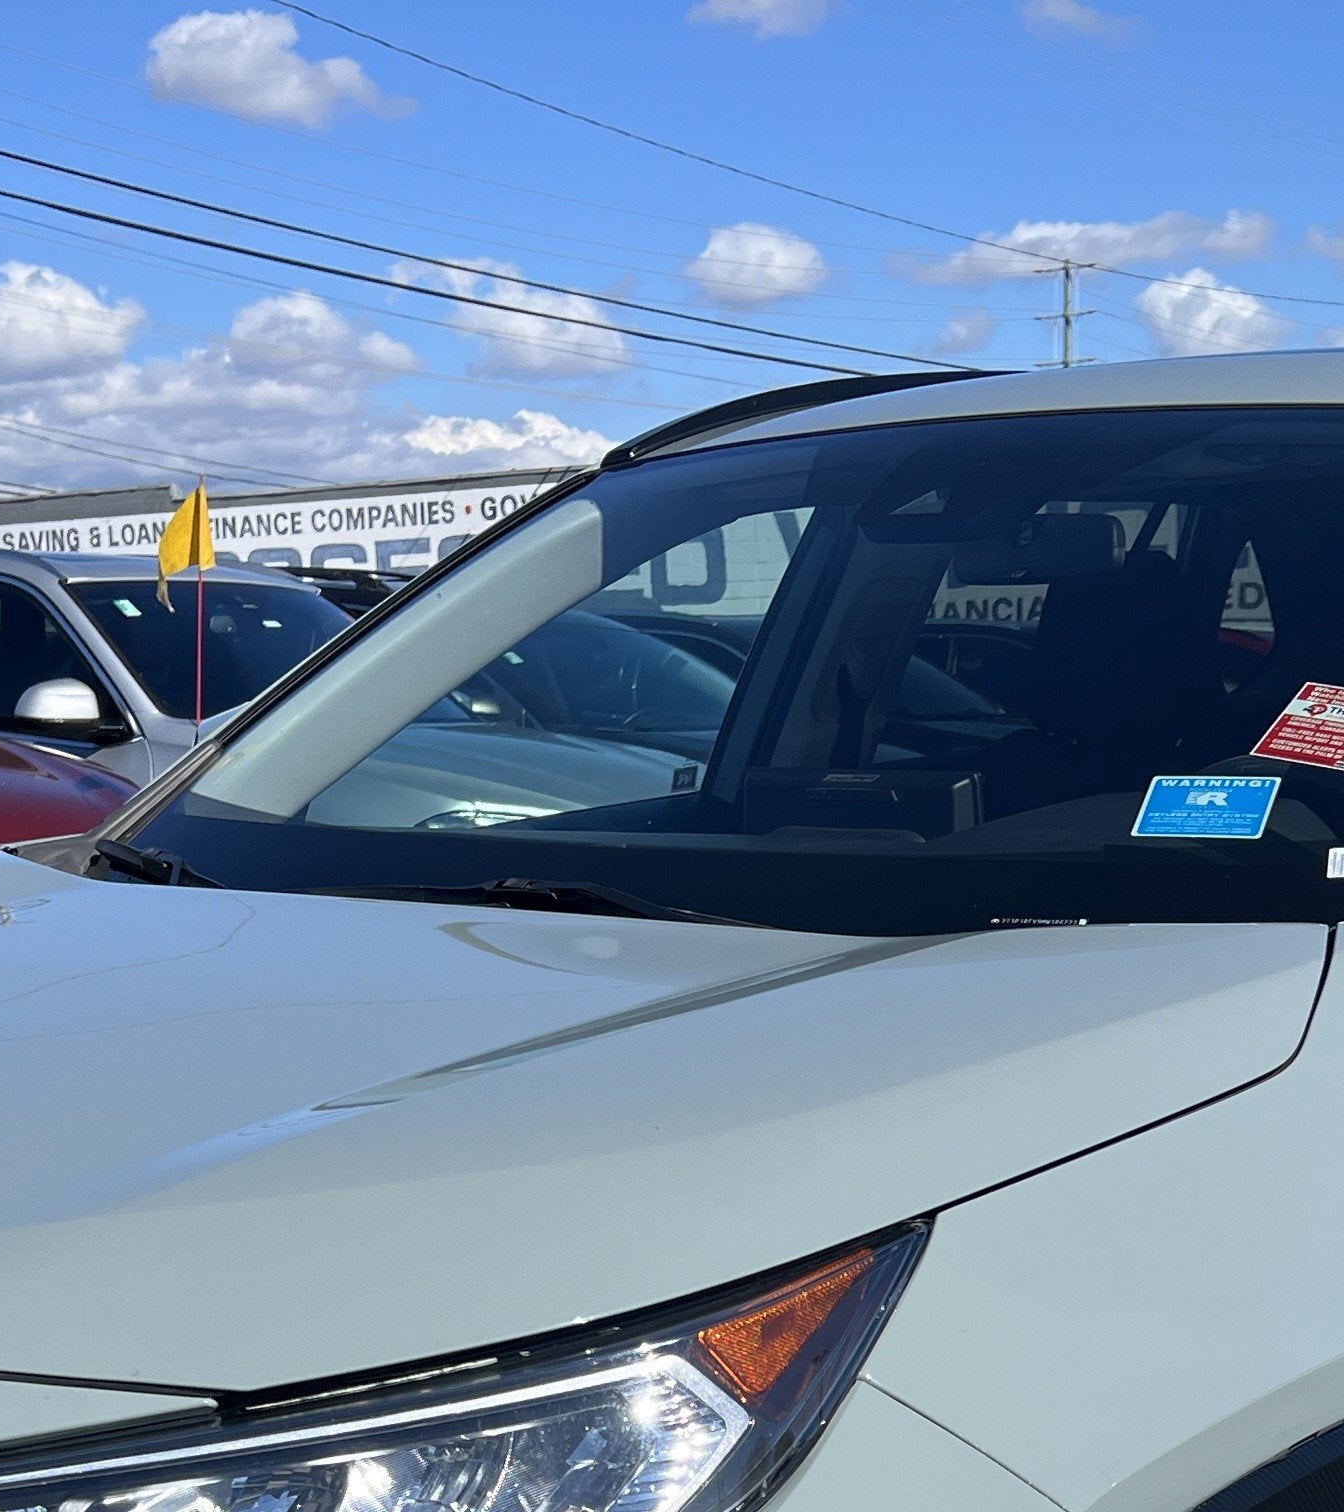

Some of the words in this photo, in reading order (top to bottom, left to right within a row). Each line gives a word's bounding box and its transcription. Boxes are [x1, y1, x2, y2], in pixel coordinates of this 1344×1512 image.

[2, 527, 79, 551] SAVING
[89, 526, 101, 547] &
[208, 511, 303, 540] INANCE
[311, 500, 455, 532] COMPANIES
[1160, 779, 1271, 788] WARNING!
